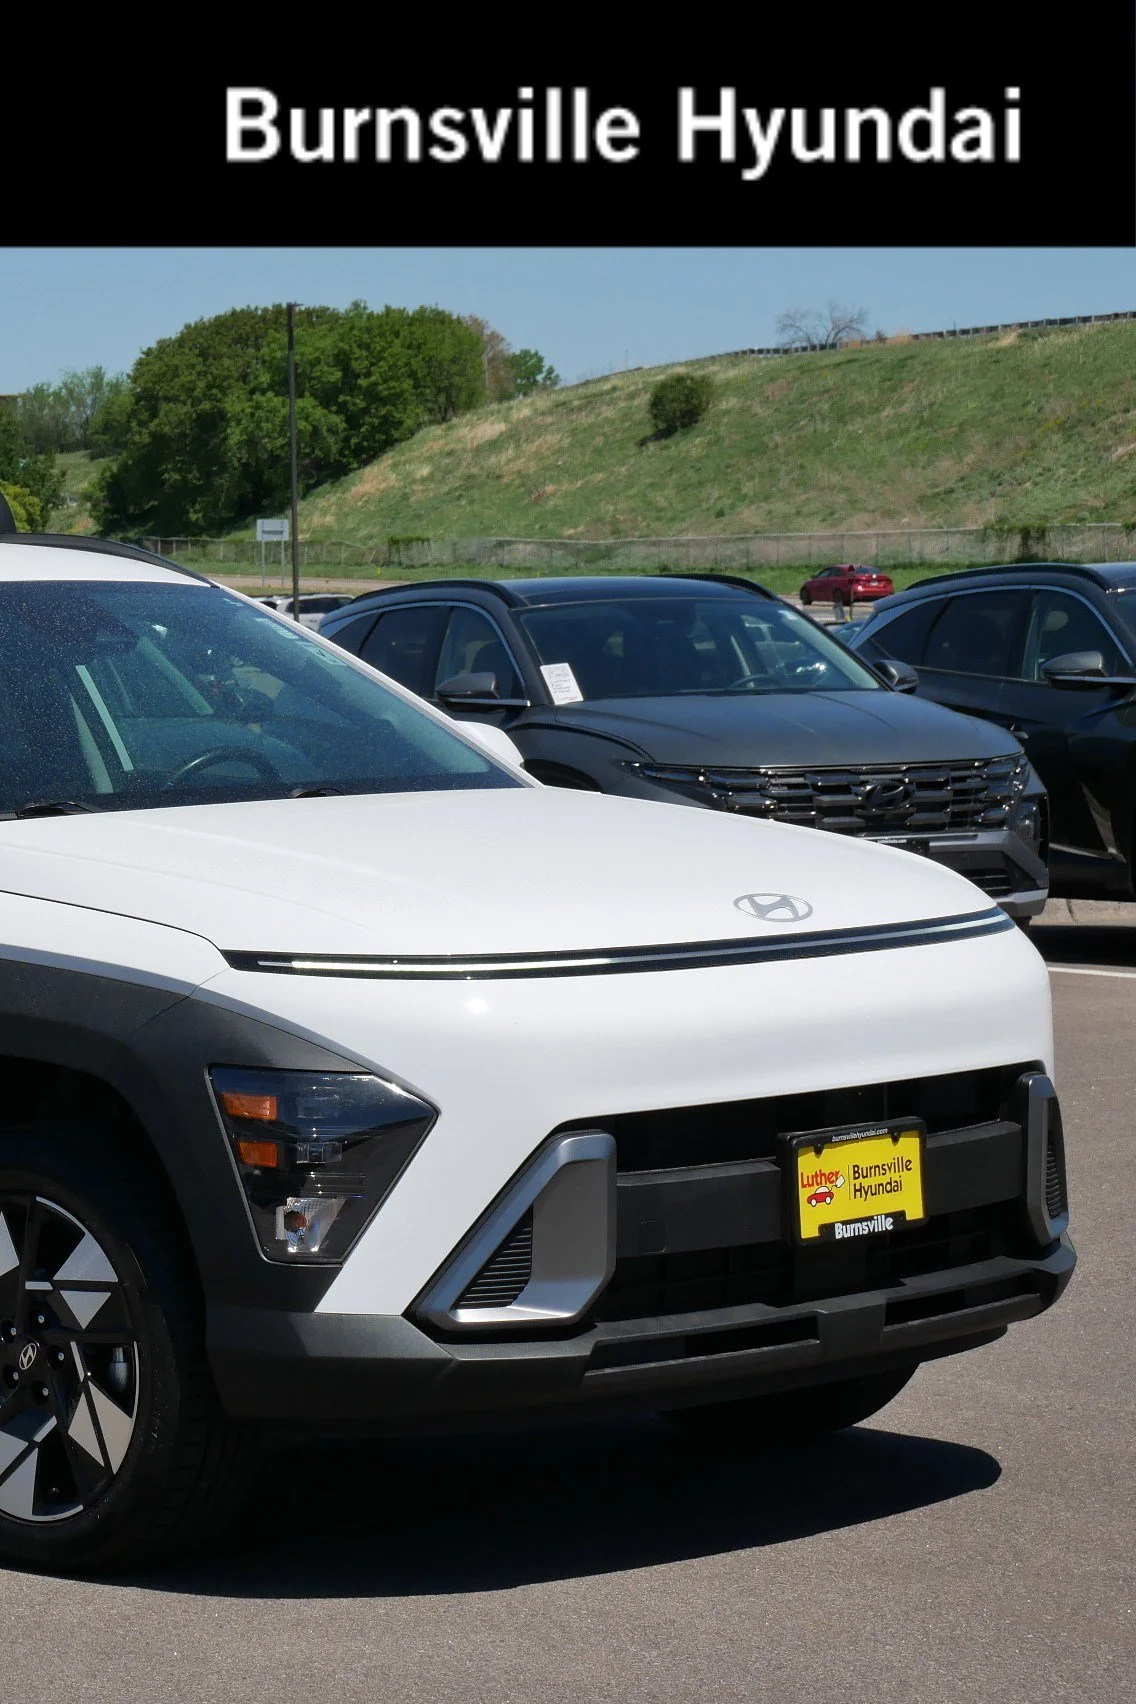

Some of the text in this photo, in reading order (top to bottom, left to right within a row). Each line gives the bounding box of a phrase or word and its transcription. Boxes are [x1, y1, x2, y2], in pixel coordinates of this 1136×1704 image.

[800, 1169, 840, 1189] Luther
[852, 1156, 913, 1181] Burnsville
[853, 1175, 903, 1202] Hyundai
[834, 1214, 894, 1240] Burnsville
